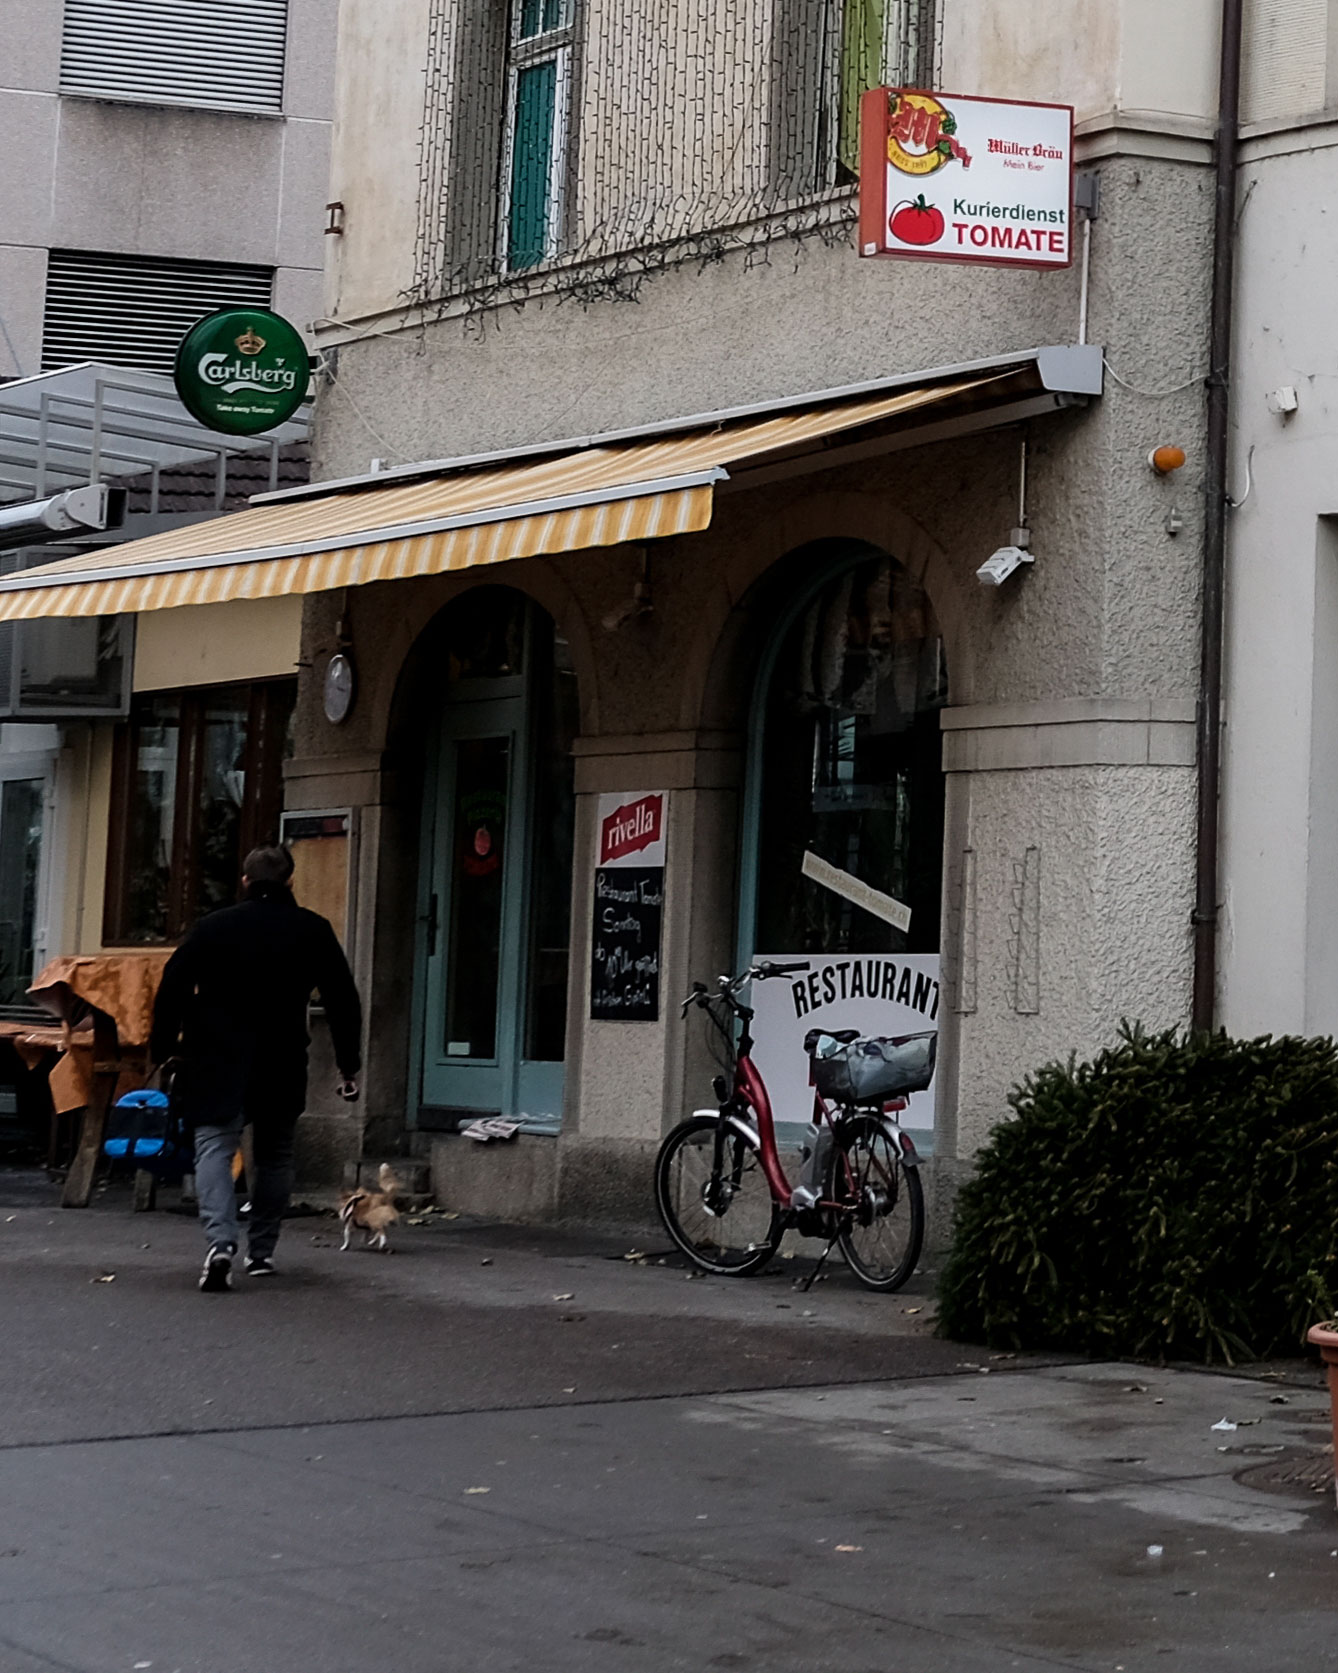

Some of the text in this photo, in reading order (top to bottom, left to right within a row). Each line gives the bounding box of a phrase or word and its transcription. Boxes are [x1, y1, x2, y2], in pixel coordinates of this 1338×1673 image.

[987, 138, 1031, 157] Müller
[1003, 160, 1025, 170] Mein
[953, 199, 1065, 224] Kurierdienst
[952, 223, 1065, 253] TOMATE
[198, 352, 297, 394] Carlsberg
[608, 804, 654, 850] rivella
[792, 960, 939, 1021] RESTAURANT
